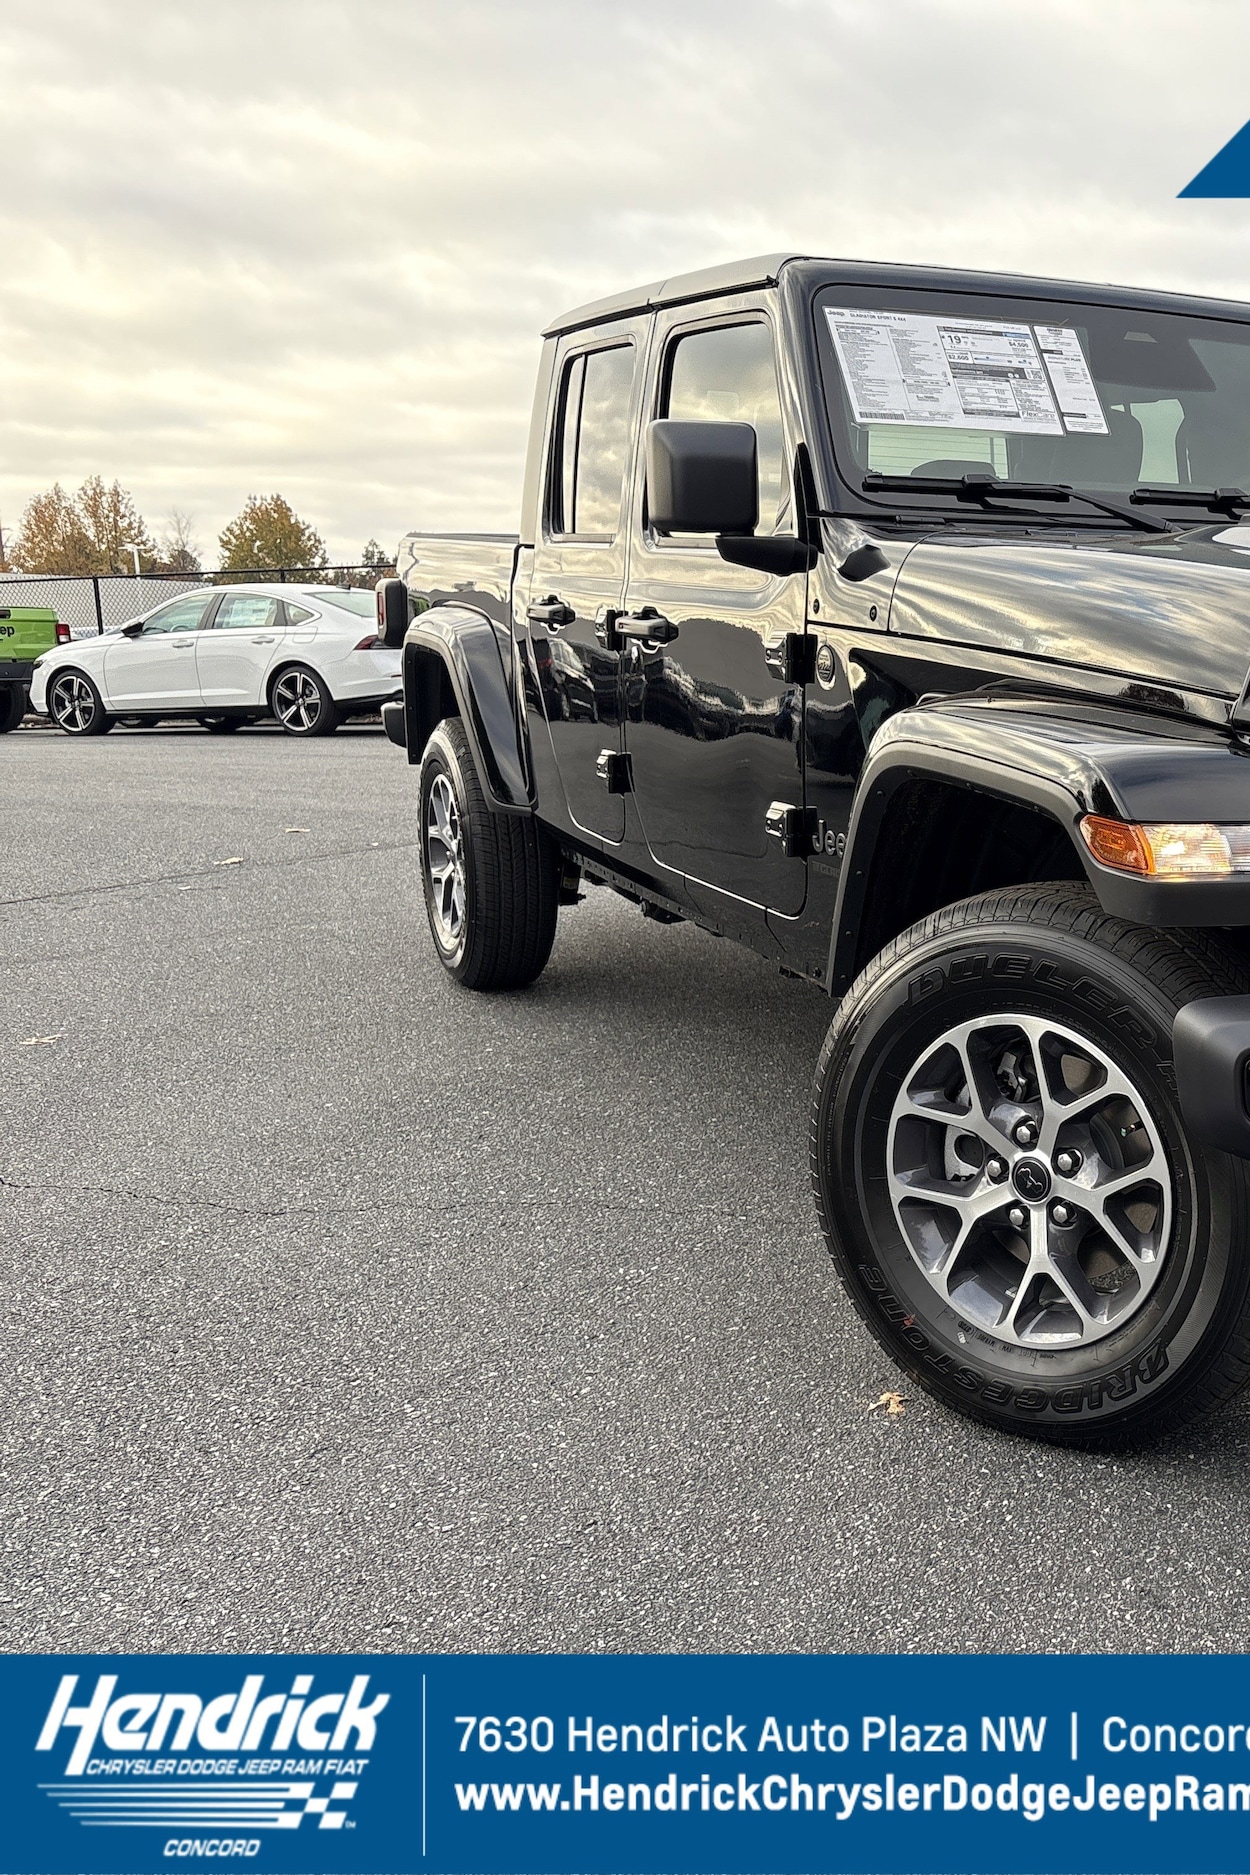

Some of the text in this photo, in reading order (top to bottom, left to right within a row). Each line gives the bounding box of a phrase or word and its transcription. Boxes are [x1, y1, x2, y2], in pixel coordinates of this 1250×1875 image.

[947, 335, 962, 344] 19
[0, 626, 15, 637] ep
[812, 819, 847, 858] Jee
[906, 952, 1160, 1051] DUELER
[857, 1263, 1170, 1413] BRIDGESTONE
